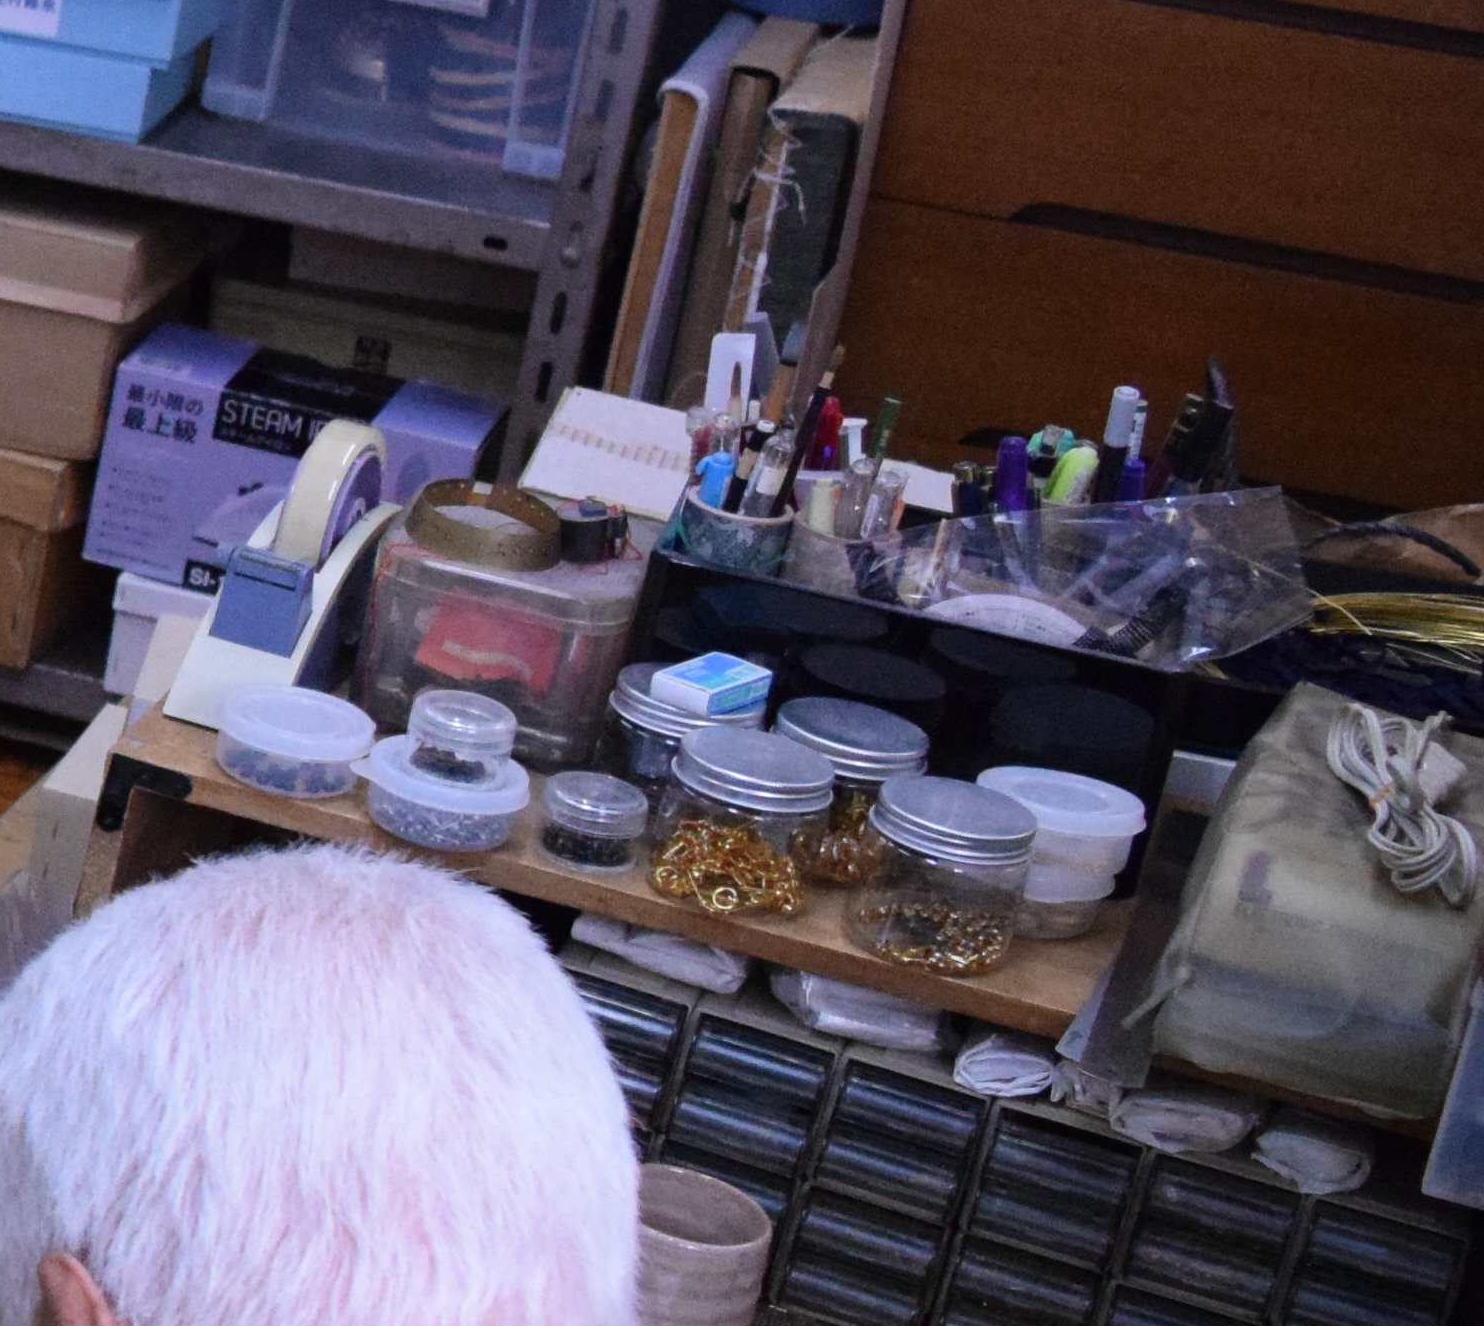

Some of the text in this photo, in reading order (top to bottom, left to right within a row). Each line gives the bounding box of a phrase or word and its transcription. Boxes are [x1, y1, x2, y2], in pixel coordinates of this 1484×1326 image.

[121, 406, 198, 445] 最上級
[221, 399, 302, 440] STEAM
[189, 567, 219, 587] SI-
